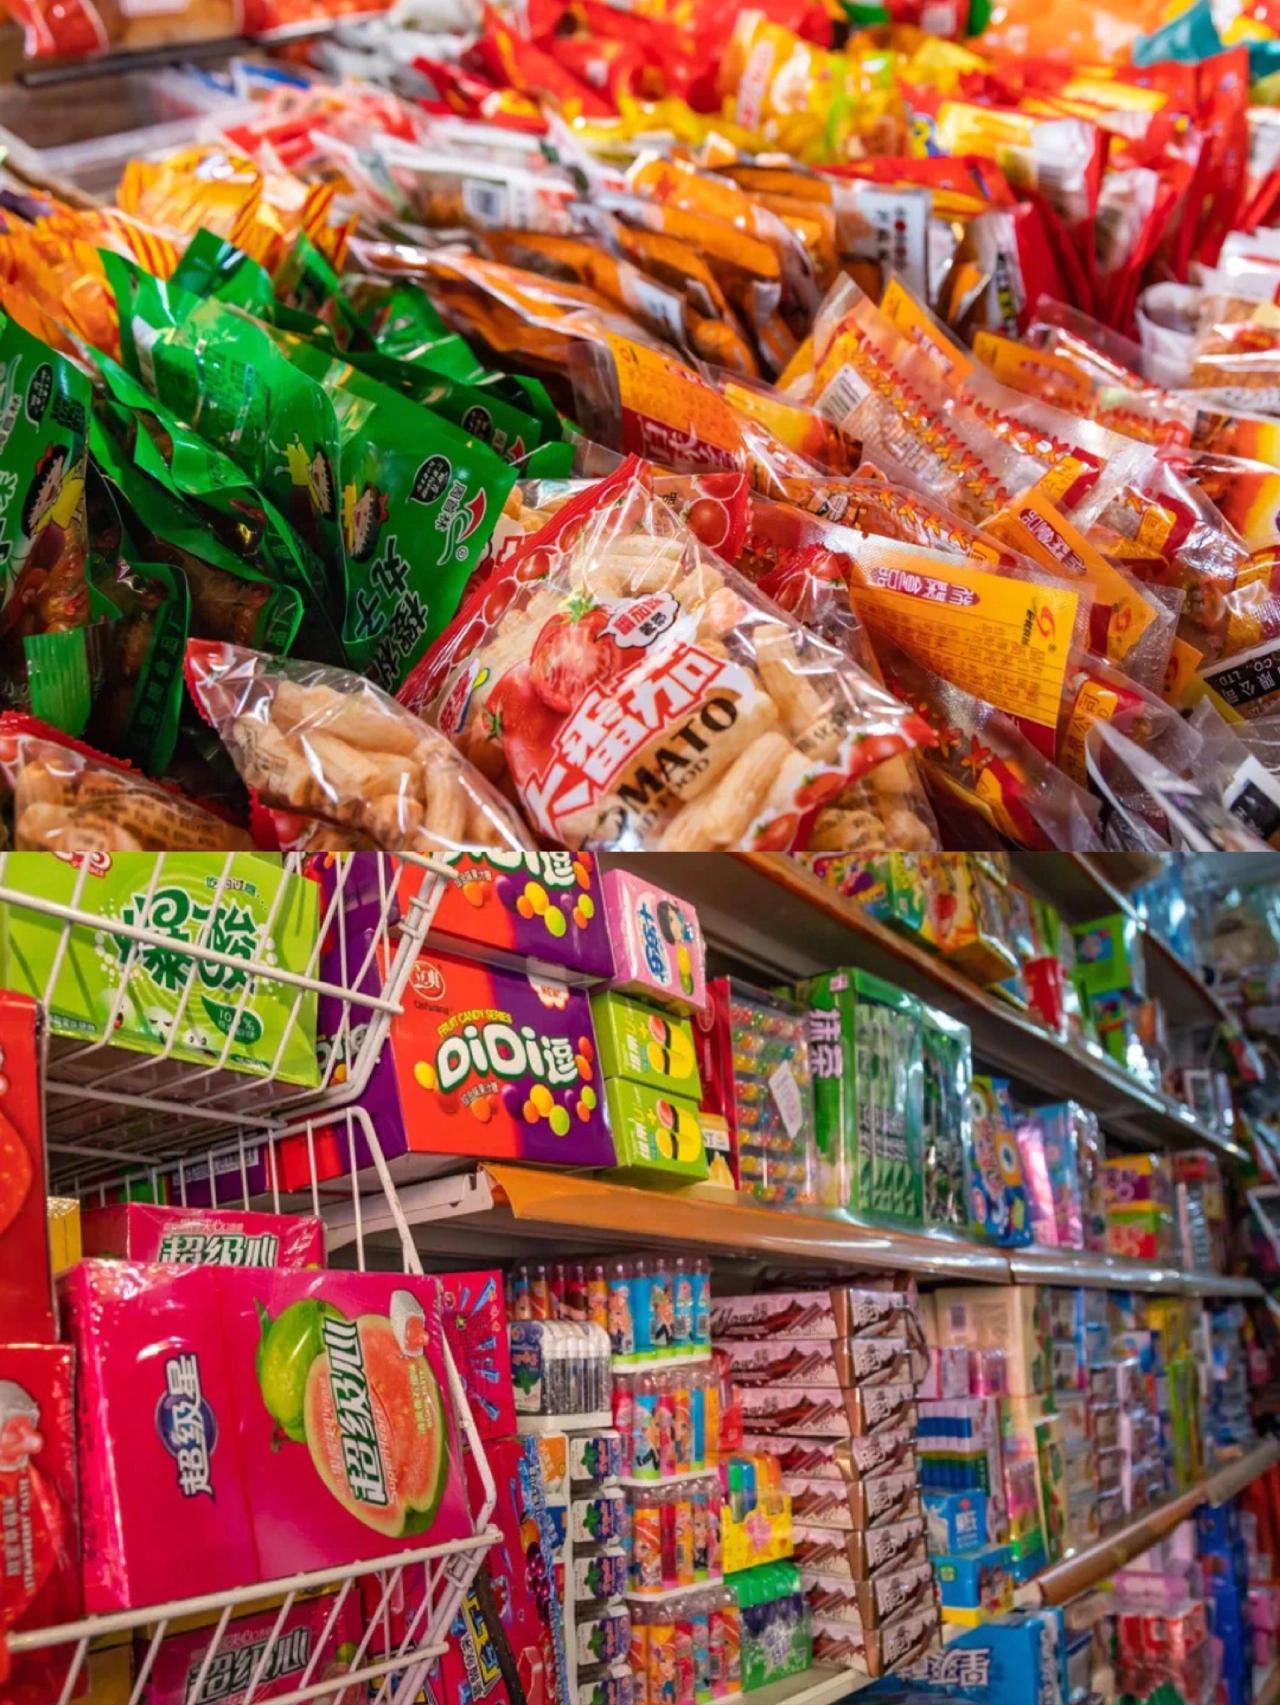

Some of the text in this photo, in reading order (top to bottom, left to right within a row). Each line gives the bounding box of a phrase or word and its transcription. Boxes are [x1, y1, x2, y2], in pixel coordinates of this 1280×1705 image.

[354, 534, 411, 642] 丸子
[438, 1021, 459, 1038] FRUIT
[458, 1010, 487, 1024] CANDY
[809, 1008, 844, 1078] 抹茶
[165, 1353, 213, 1497] 超级星
[321, 1315, 389, 1506] 超级心
